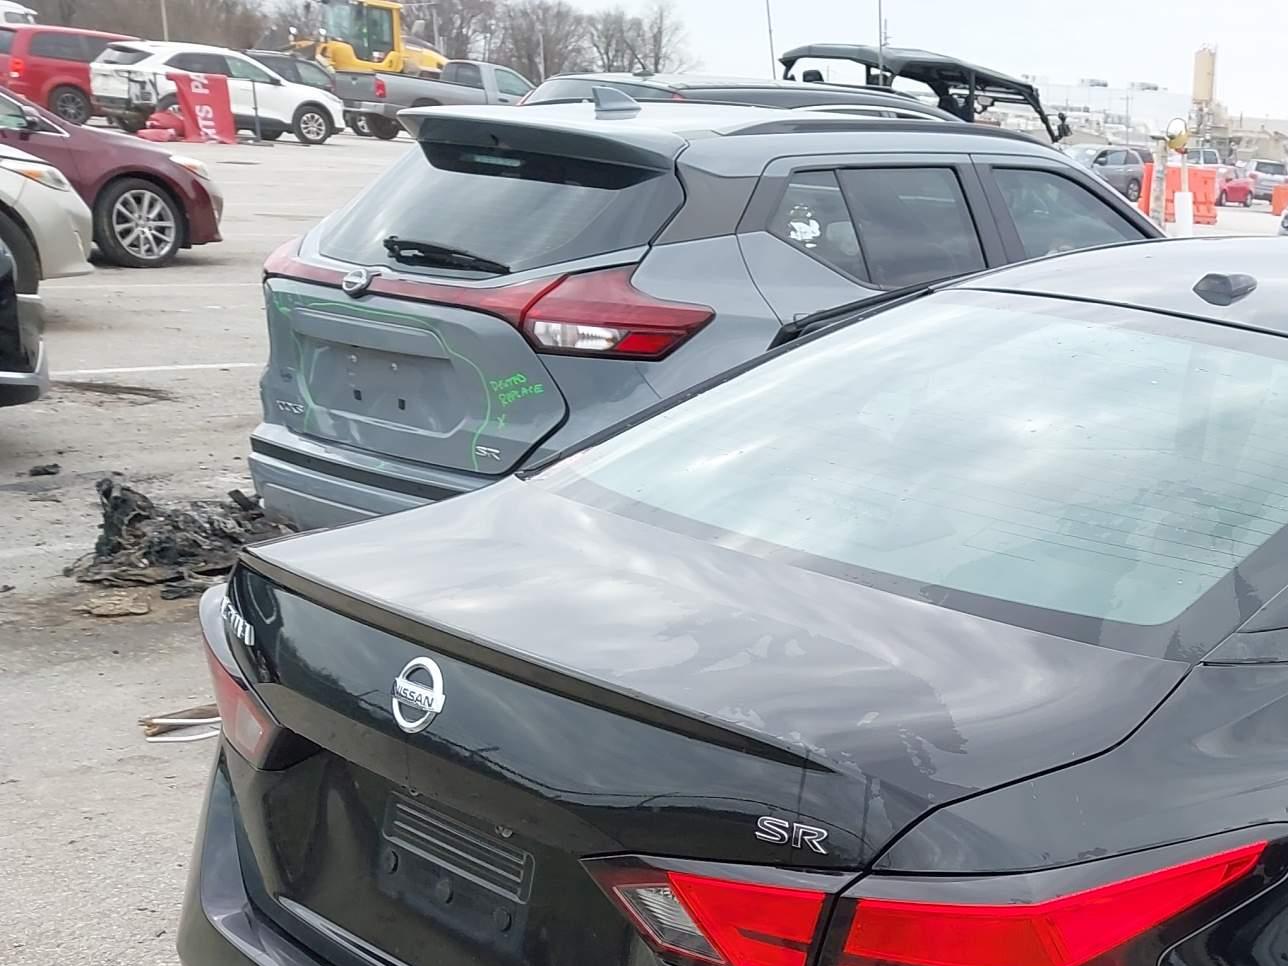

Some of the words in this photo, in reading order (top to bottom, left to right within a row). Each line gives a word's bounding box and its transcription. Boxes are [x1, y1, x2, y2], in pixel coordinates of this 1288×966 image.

[475, 445, 501, 461] SR
[393, 683, 435, 709] NISSAN
[755, 816, 828, 855] SR
